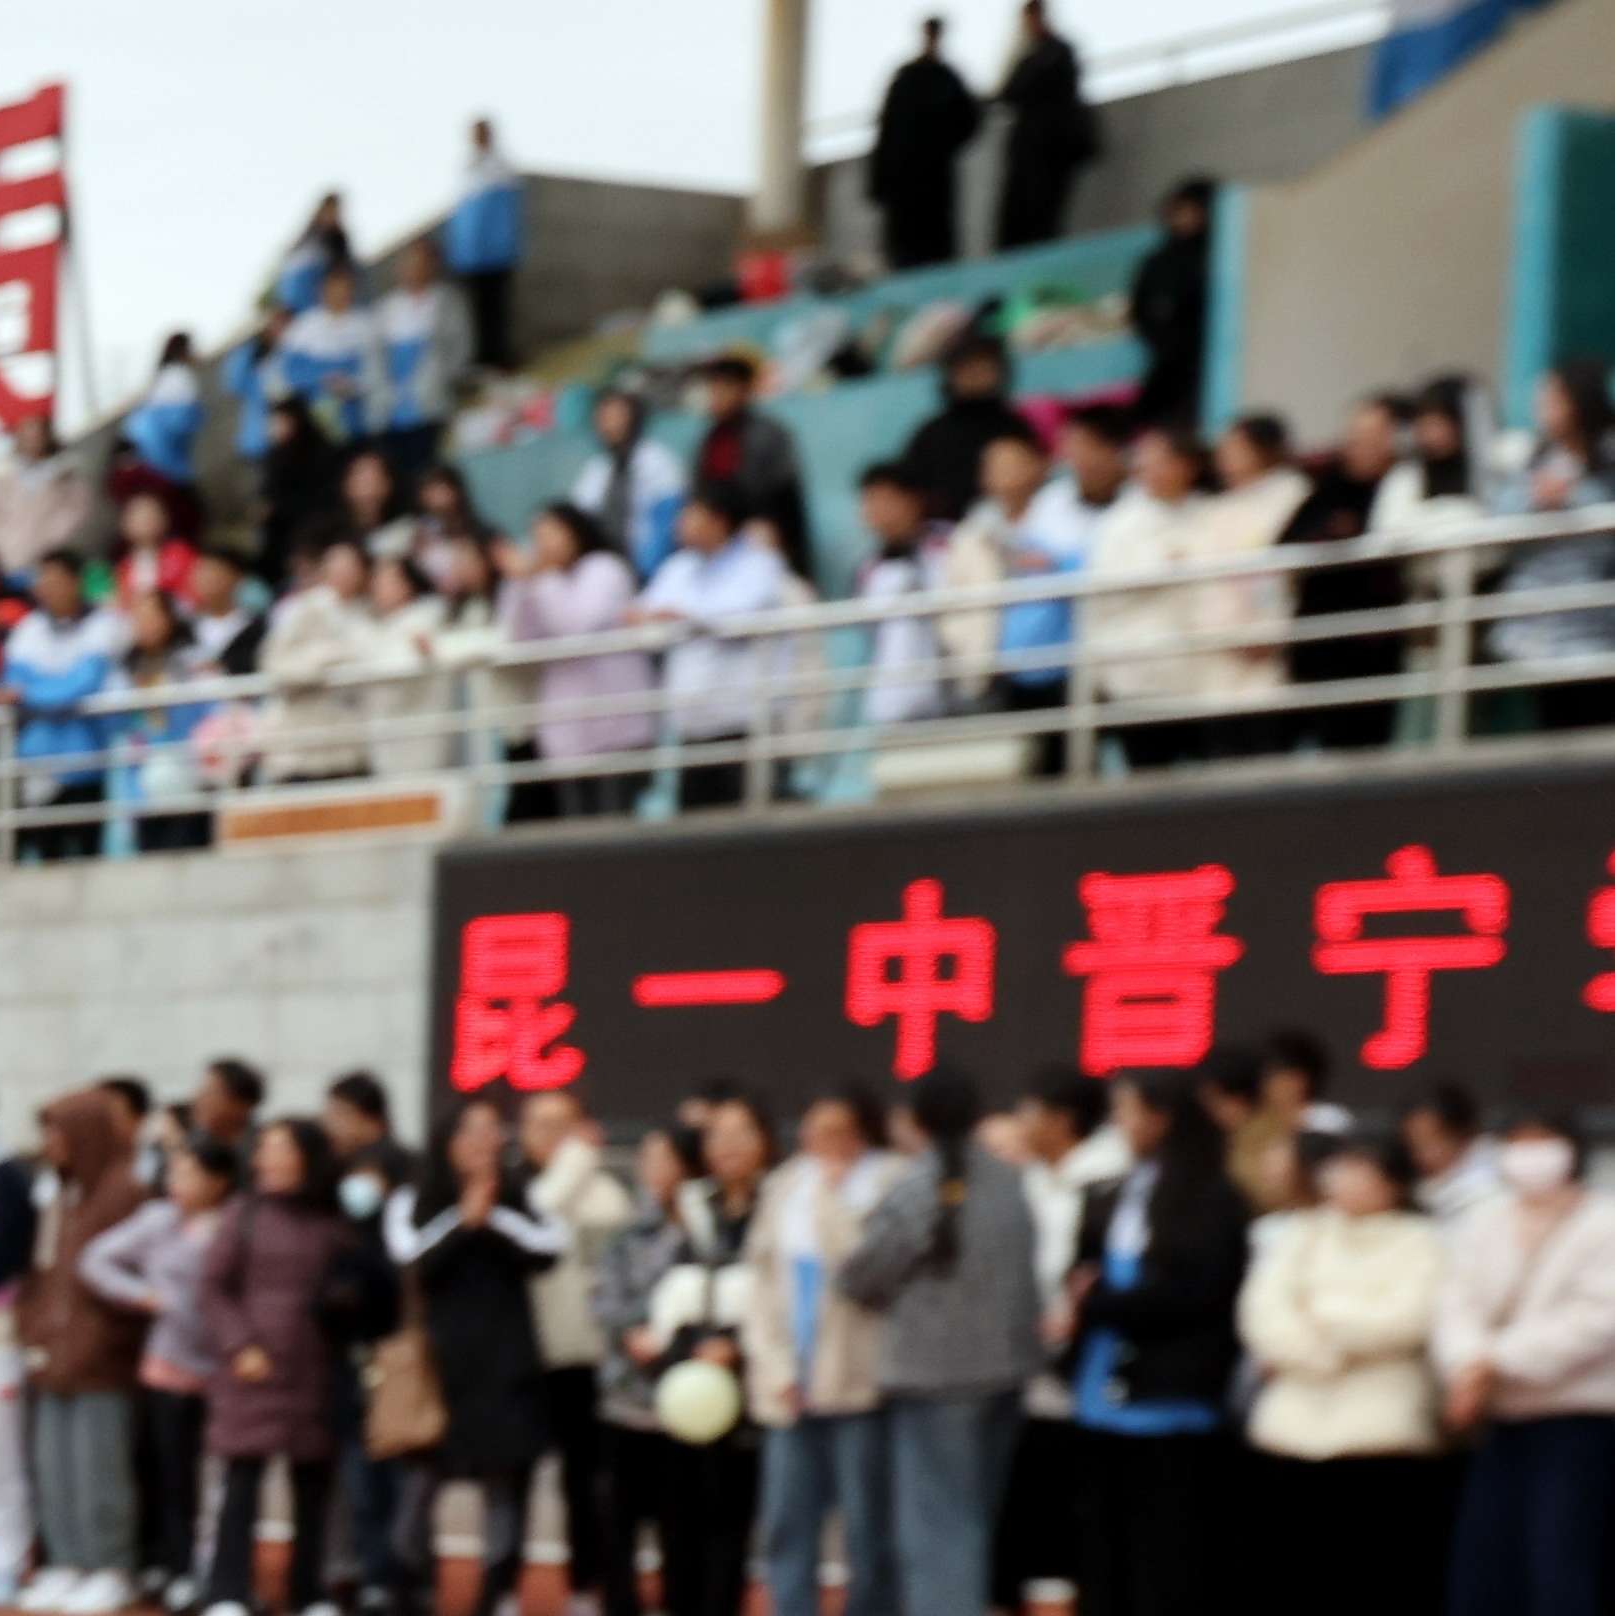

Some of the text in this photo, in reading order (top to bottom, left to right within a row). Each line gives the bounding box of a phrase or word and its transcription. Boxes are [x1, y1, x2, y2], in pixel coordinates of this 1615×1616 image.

[452, 846, 1615, 1091] 昆一中晋宁
